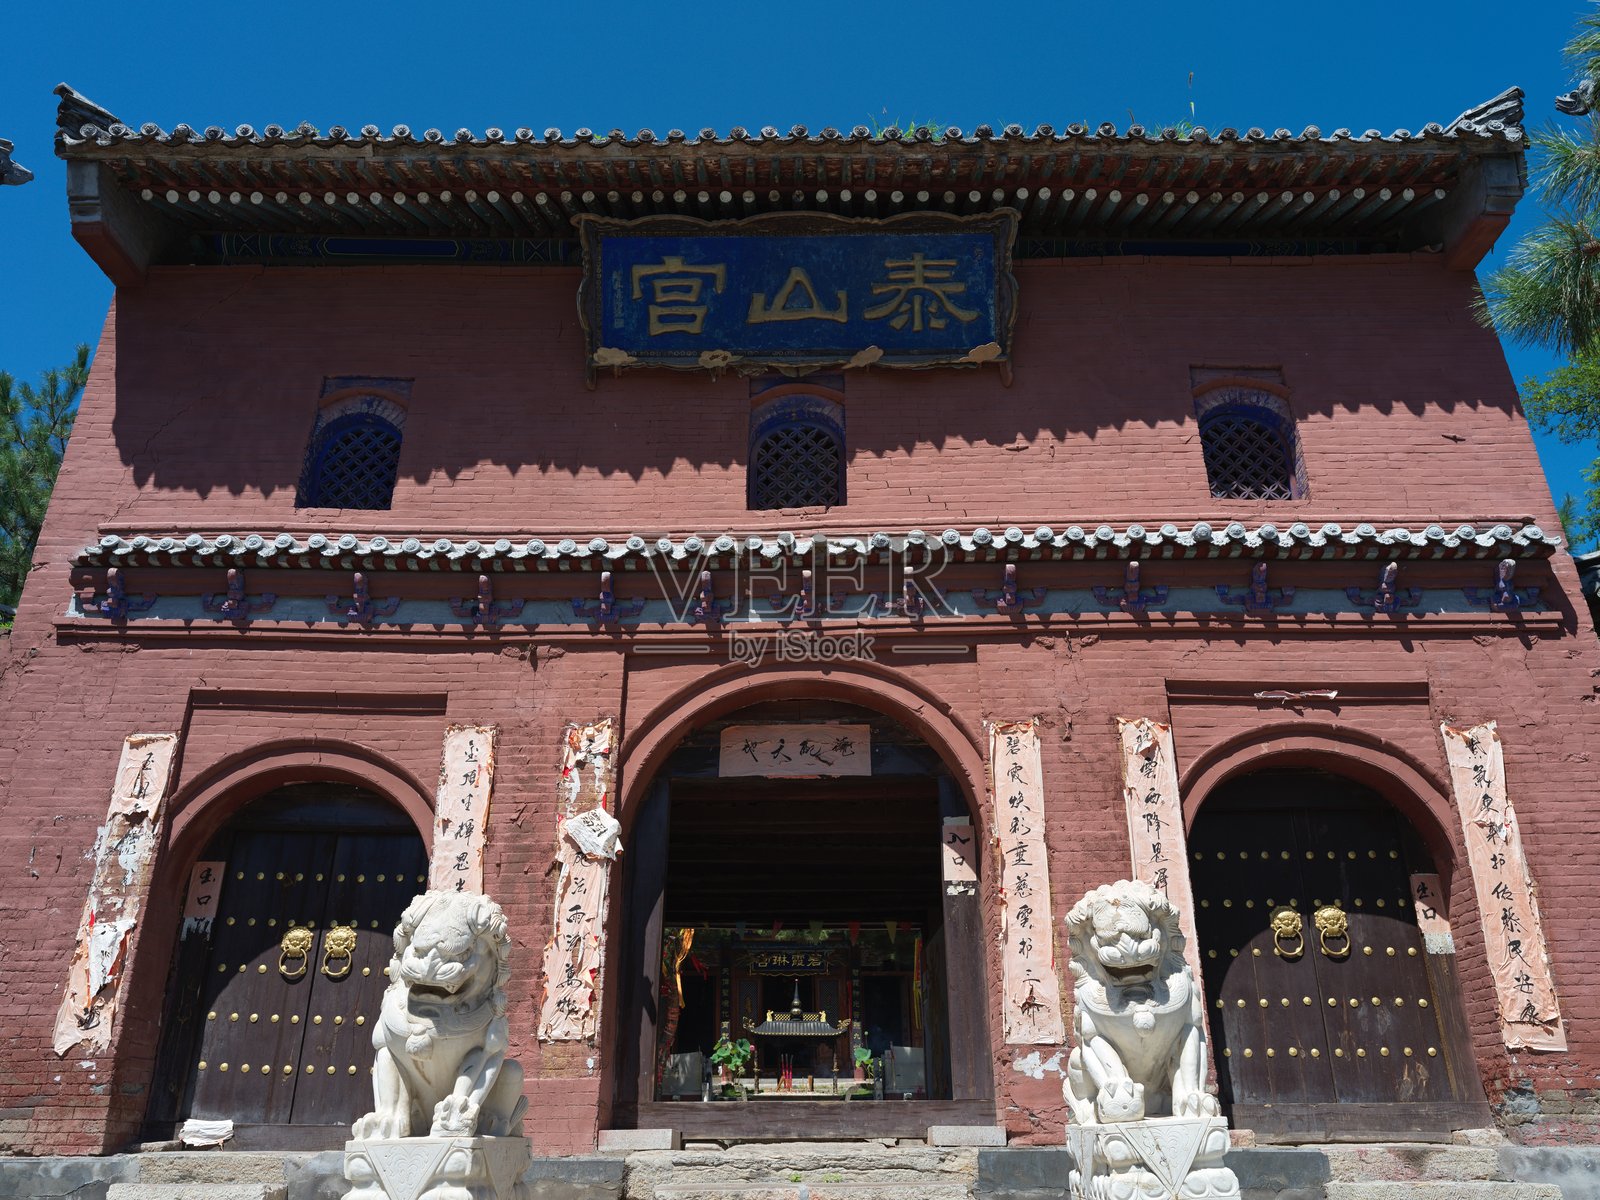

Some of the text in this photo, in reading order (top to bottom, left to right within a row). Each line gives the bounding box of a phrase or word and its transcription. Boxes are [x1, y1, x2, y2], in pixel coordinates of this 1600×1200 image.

[630, 252, 980, 337] 泰山宫
[1416, 881, 1437, 920] 出口
